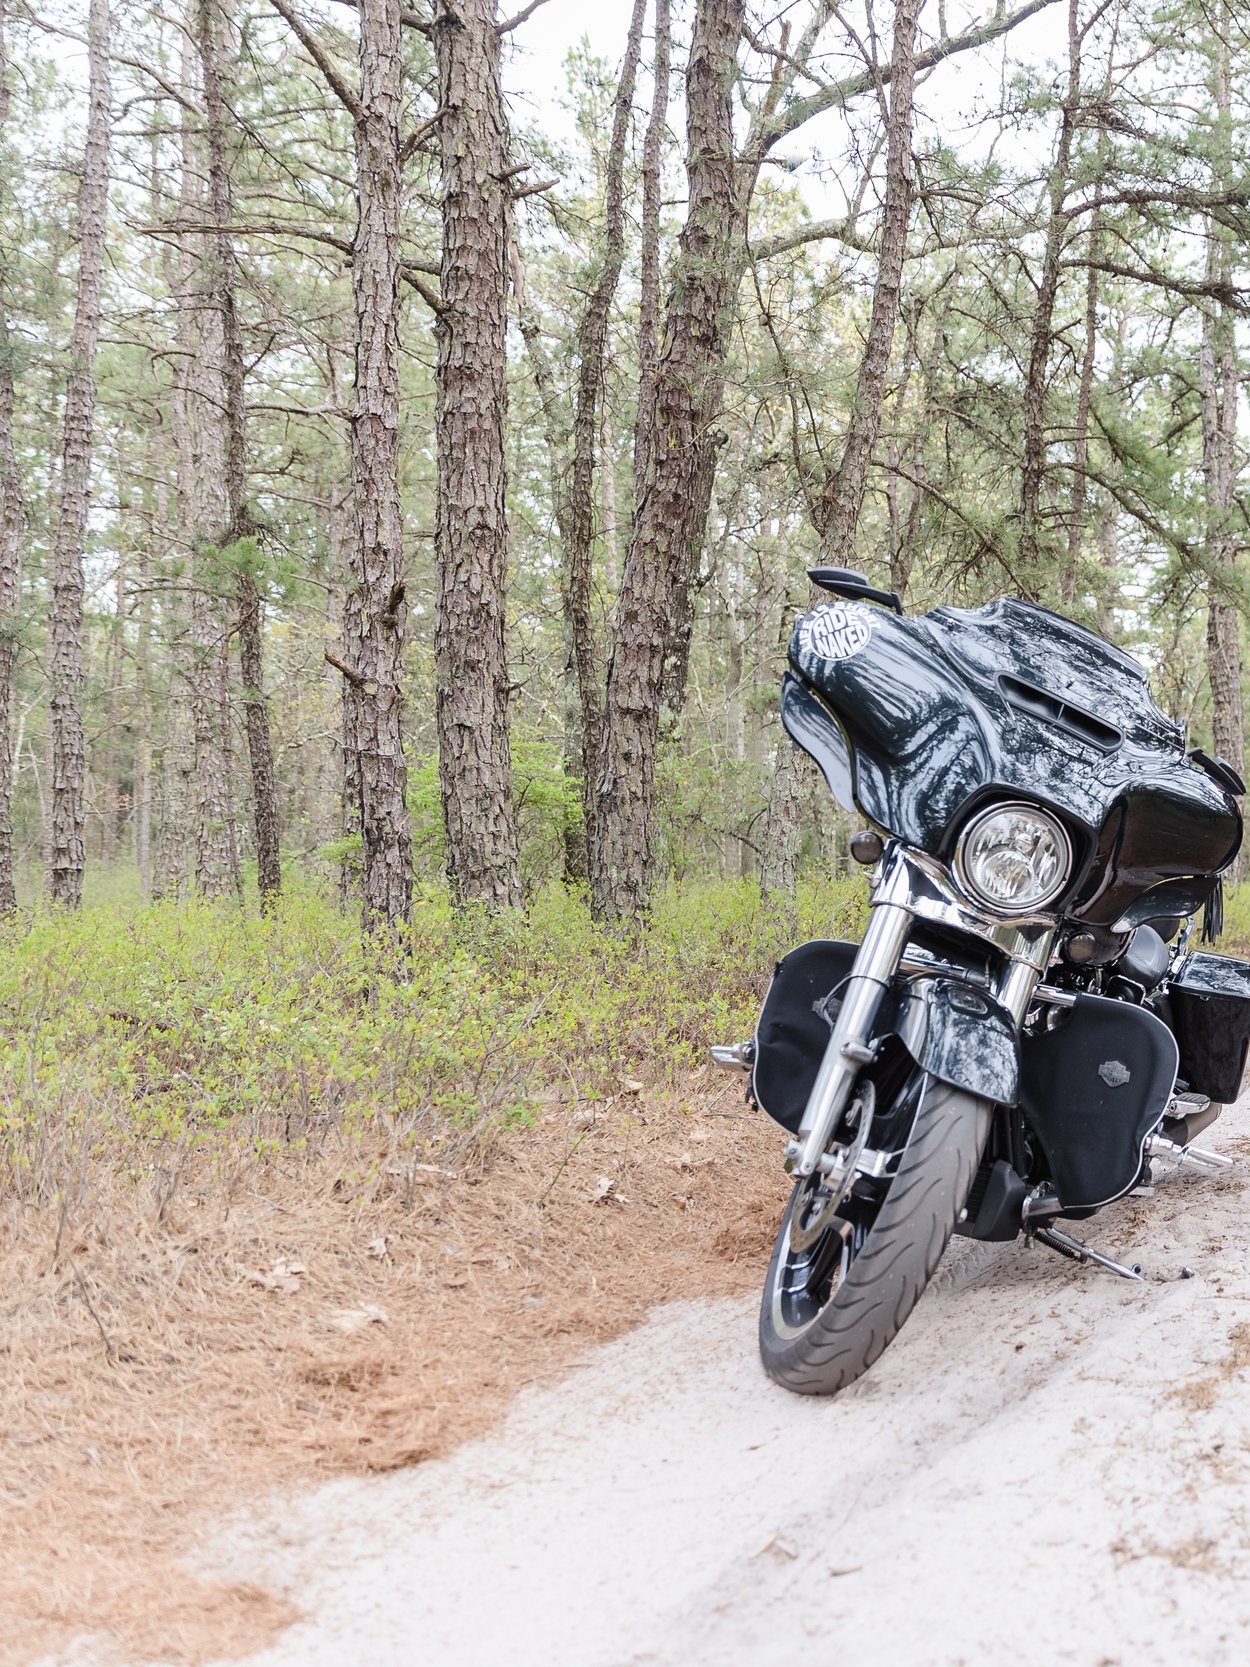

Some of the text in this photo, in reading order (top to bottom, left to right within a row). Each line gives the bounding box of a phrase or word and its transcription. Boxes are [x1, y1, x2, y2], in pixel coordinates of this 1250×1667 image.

[799, 602, 881, 652] LIFE IS SHORT
[813, 609, 861, 638] RIDE
[815, 623, 869, 658] NAKED
